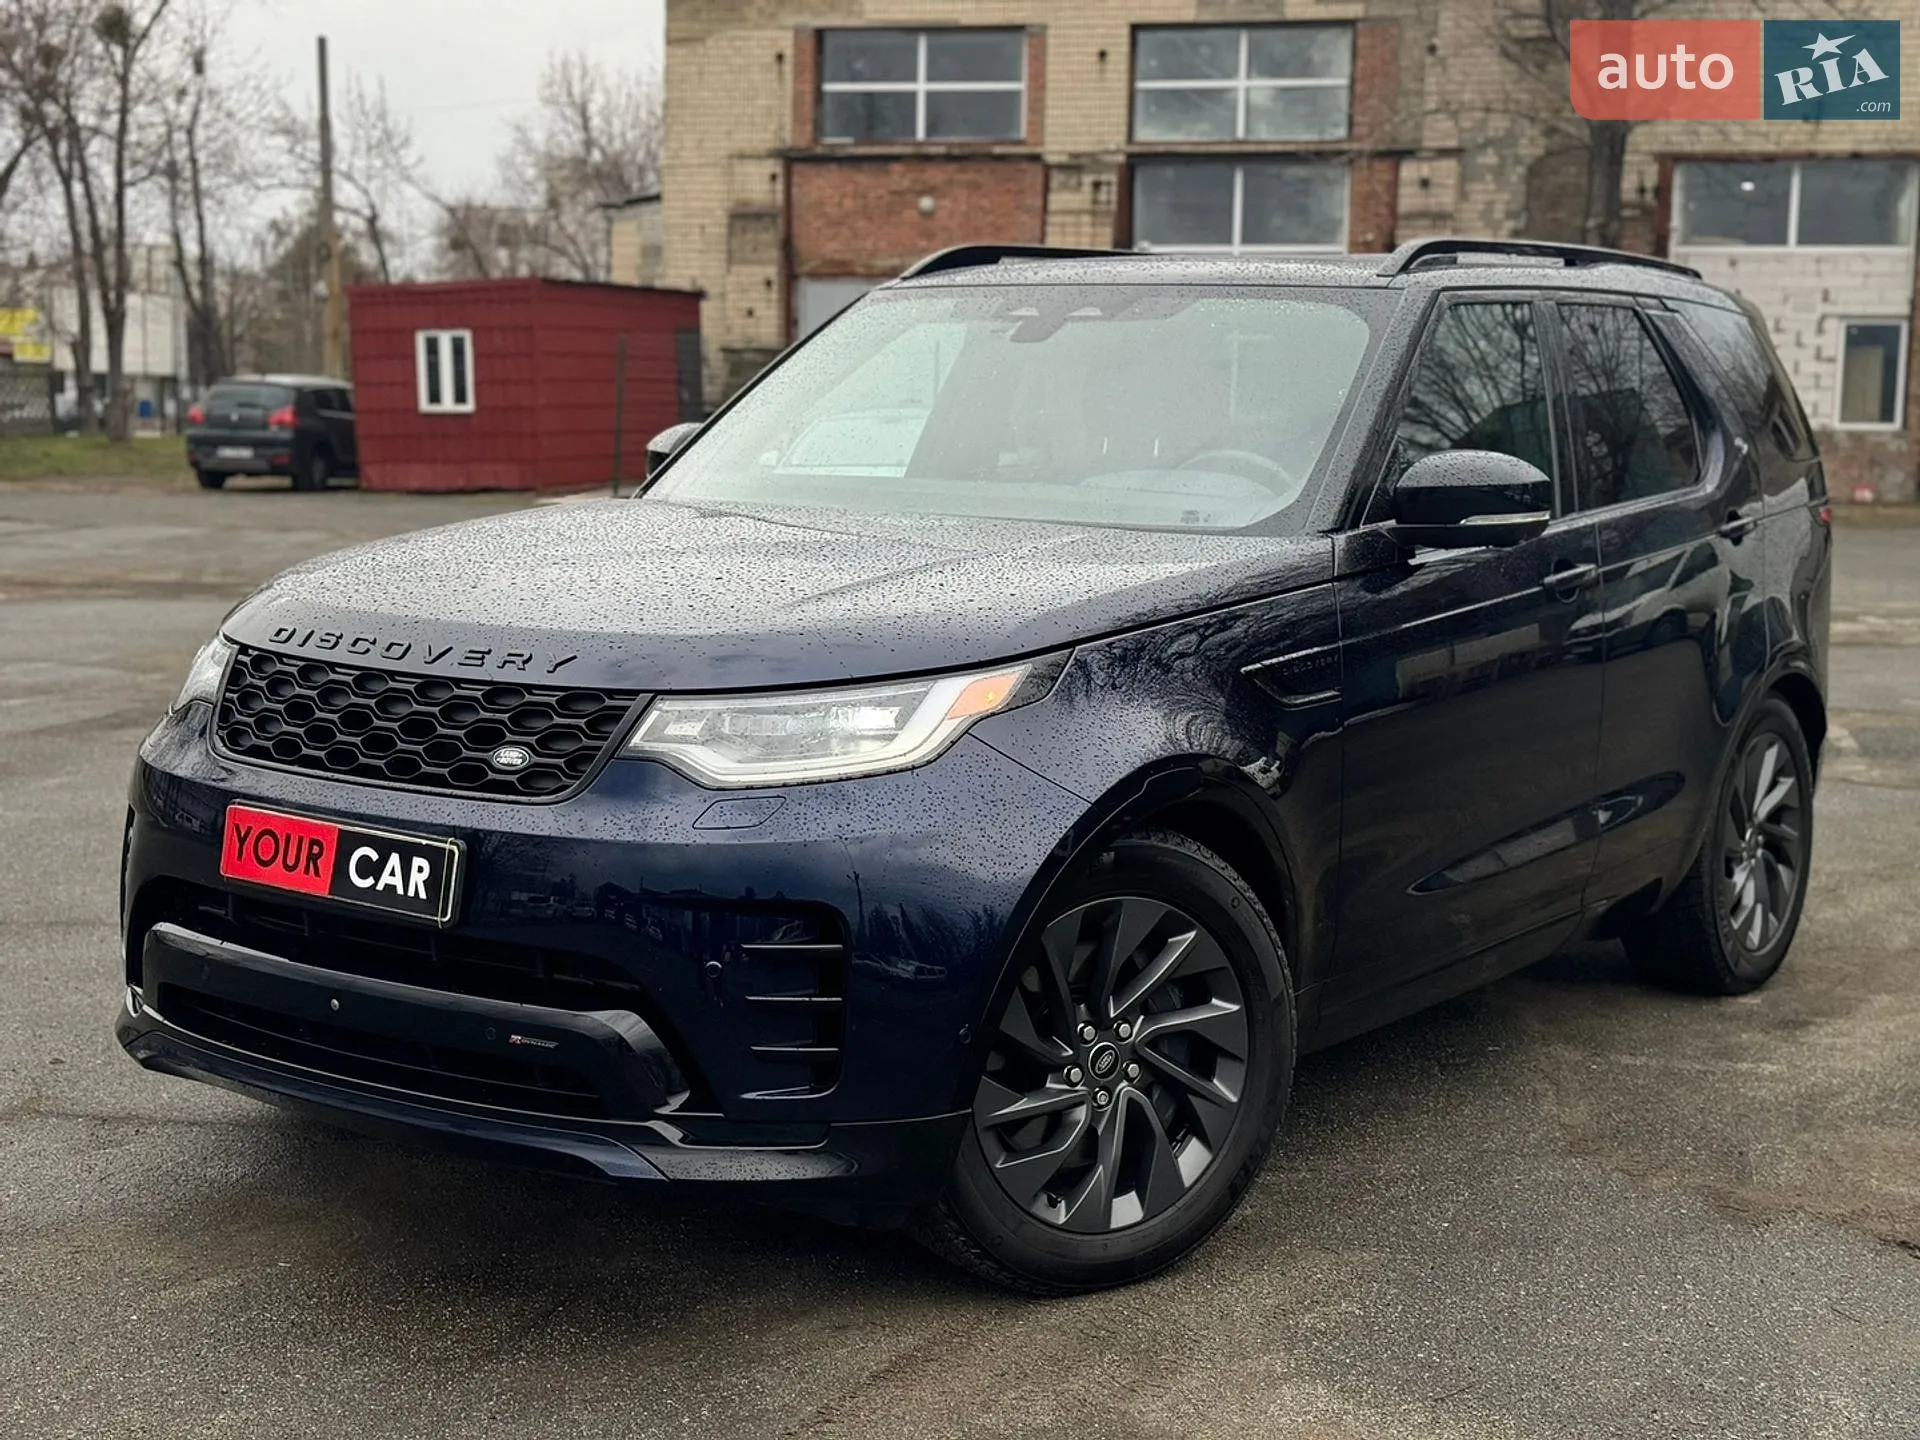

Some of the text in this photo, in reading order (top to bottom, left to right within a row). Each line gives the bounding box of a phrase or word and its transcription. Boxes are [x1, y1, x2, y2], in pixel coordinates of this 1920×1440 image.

[268, 626, 578, 674] DISCOVERY
[233, 822, 431, 900] YOUR CAR
